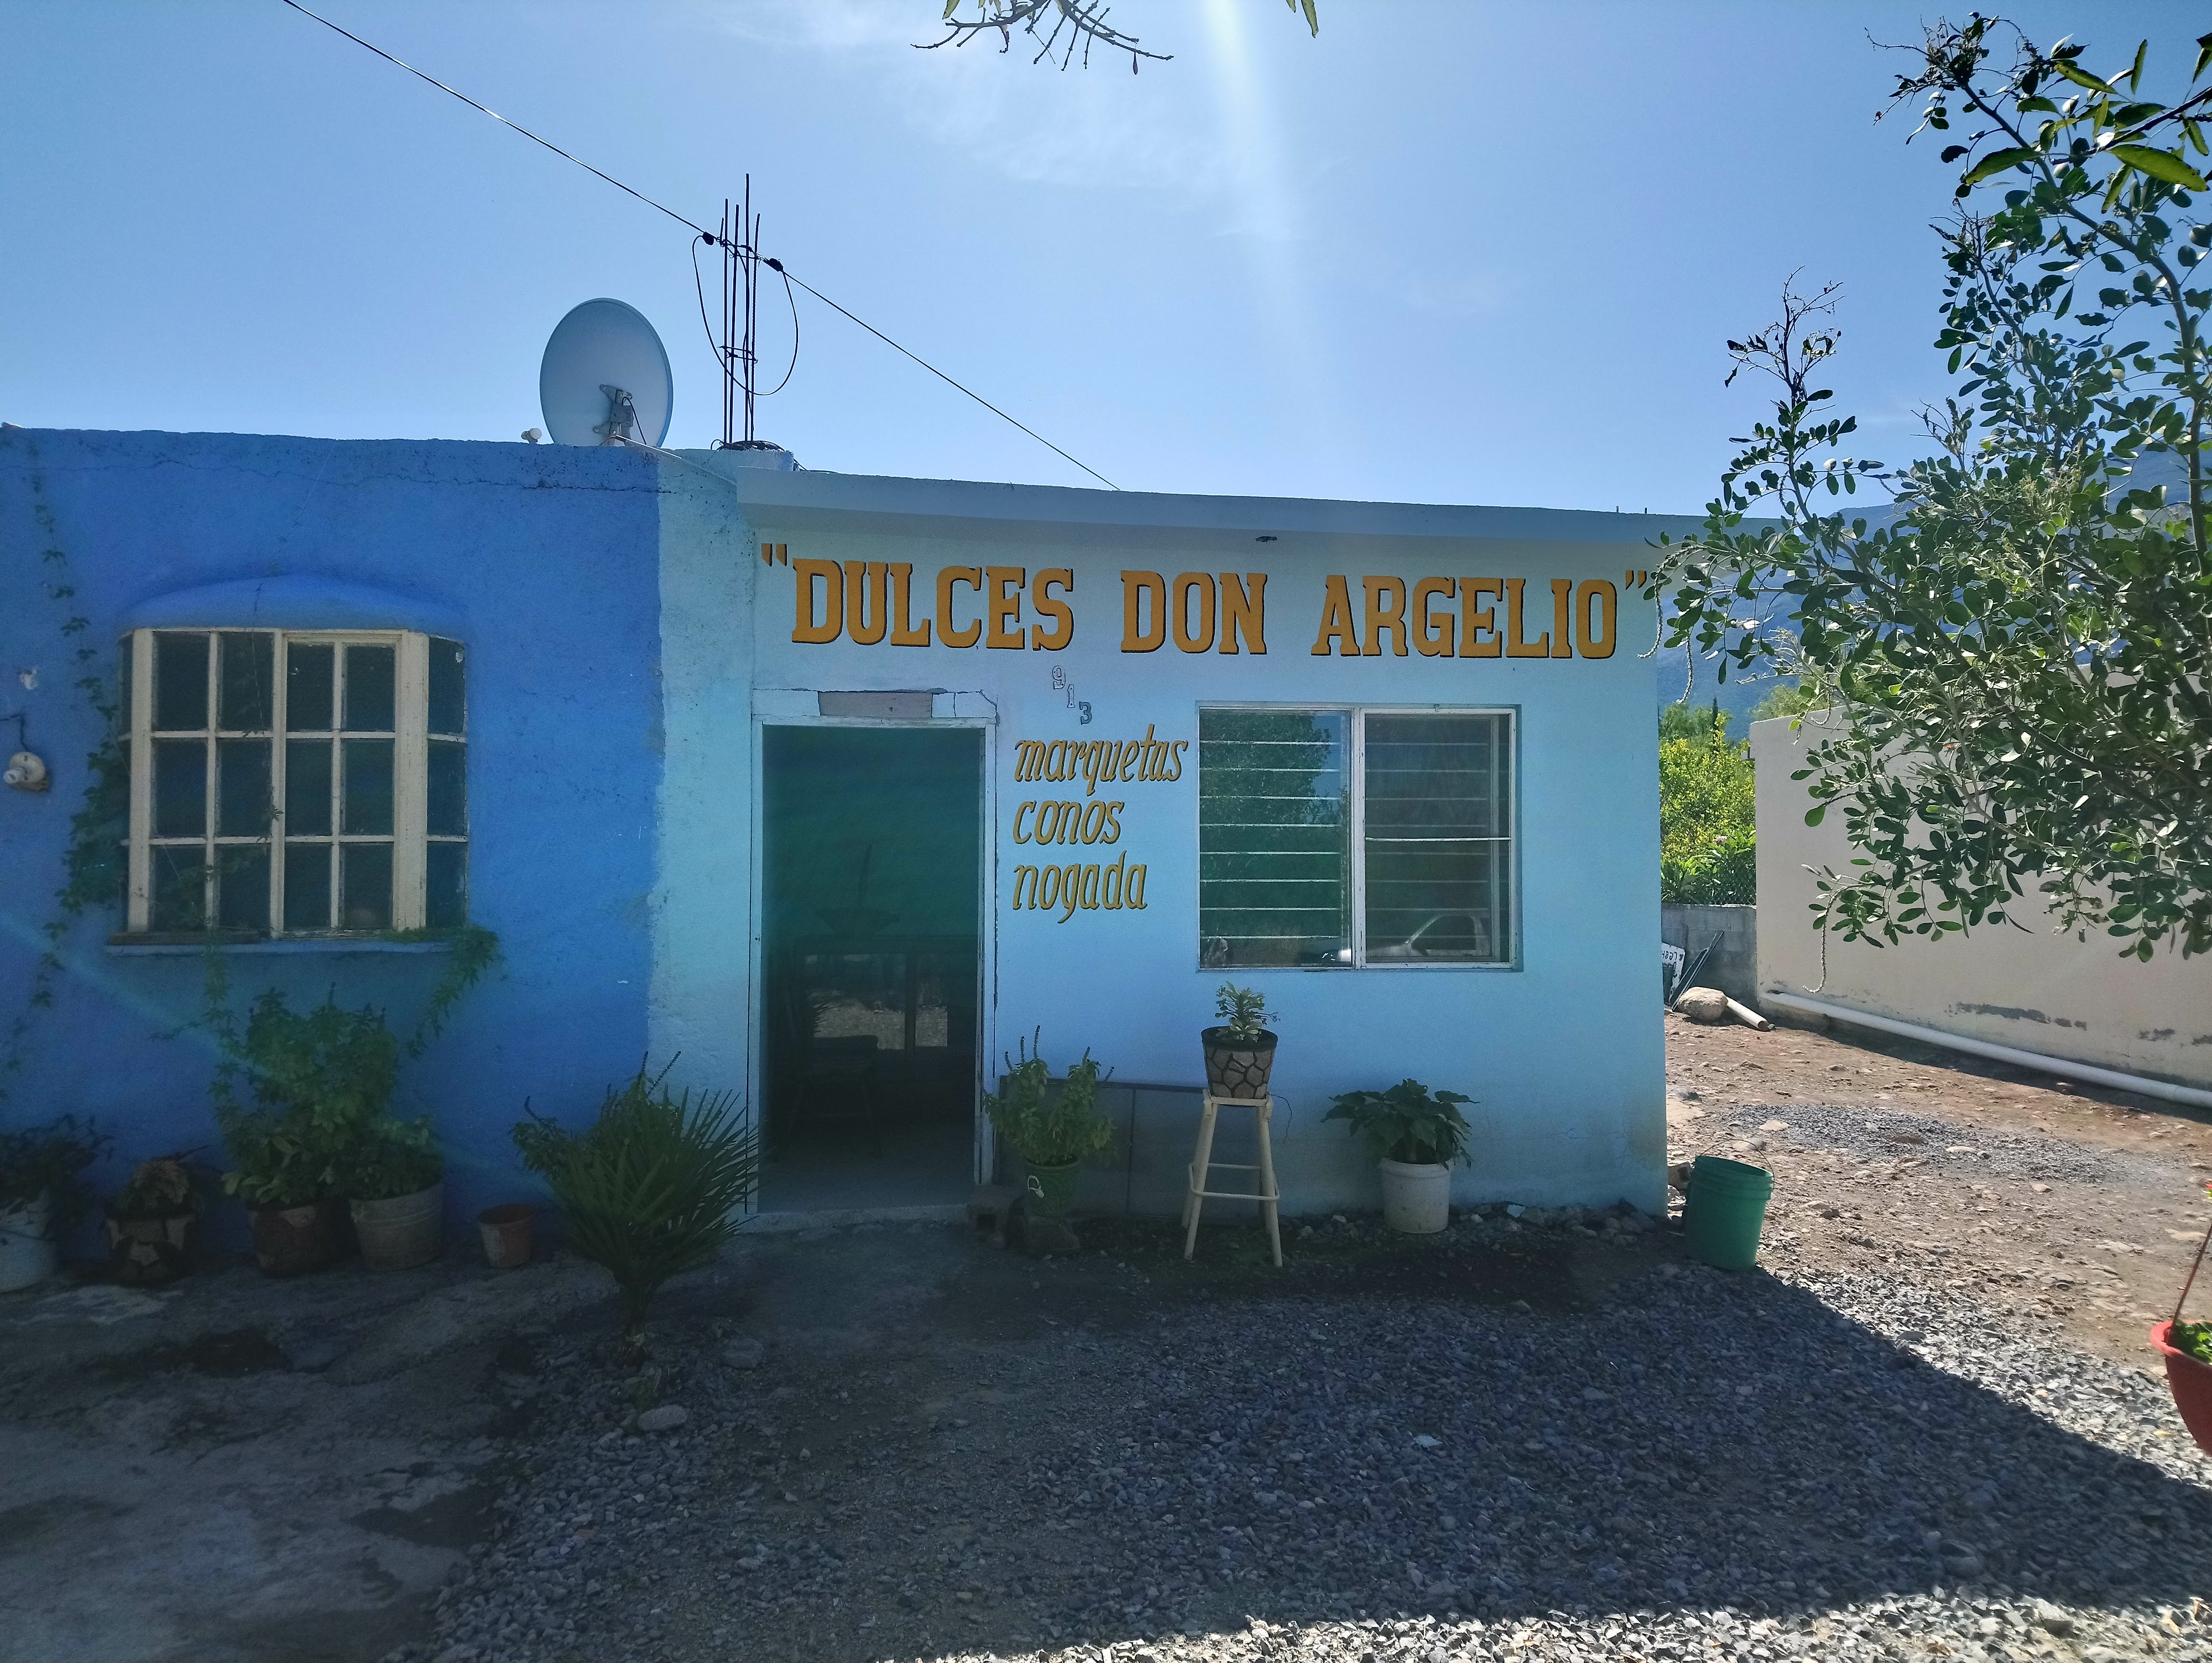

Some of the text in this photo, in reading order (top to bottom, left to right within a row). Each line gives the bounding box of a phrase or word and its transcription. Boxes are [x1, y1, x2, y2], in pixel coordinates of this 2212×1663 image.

[1120, 570, 1267, 656] DON
[1014, 723, 1188, 796] marquetas
[1013, 800, 1125, 845] conos
[1013, 850, 1147, 924] nogada
